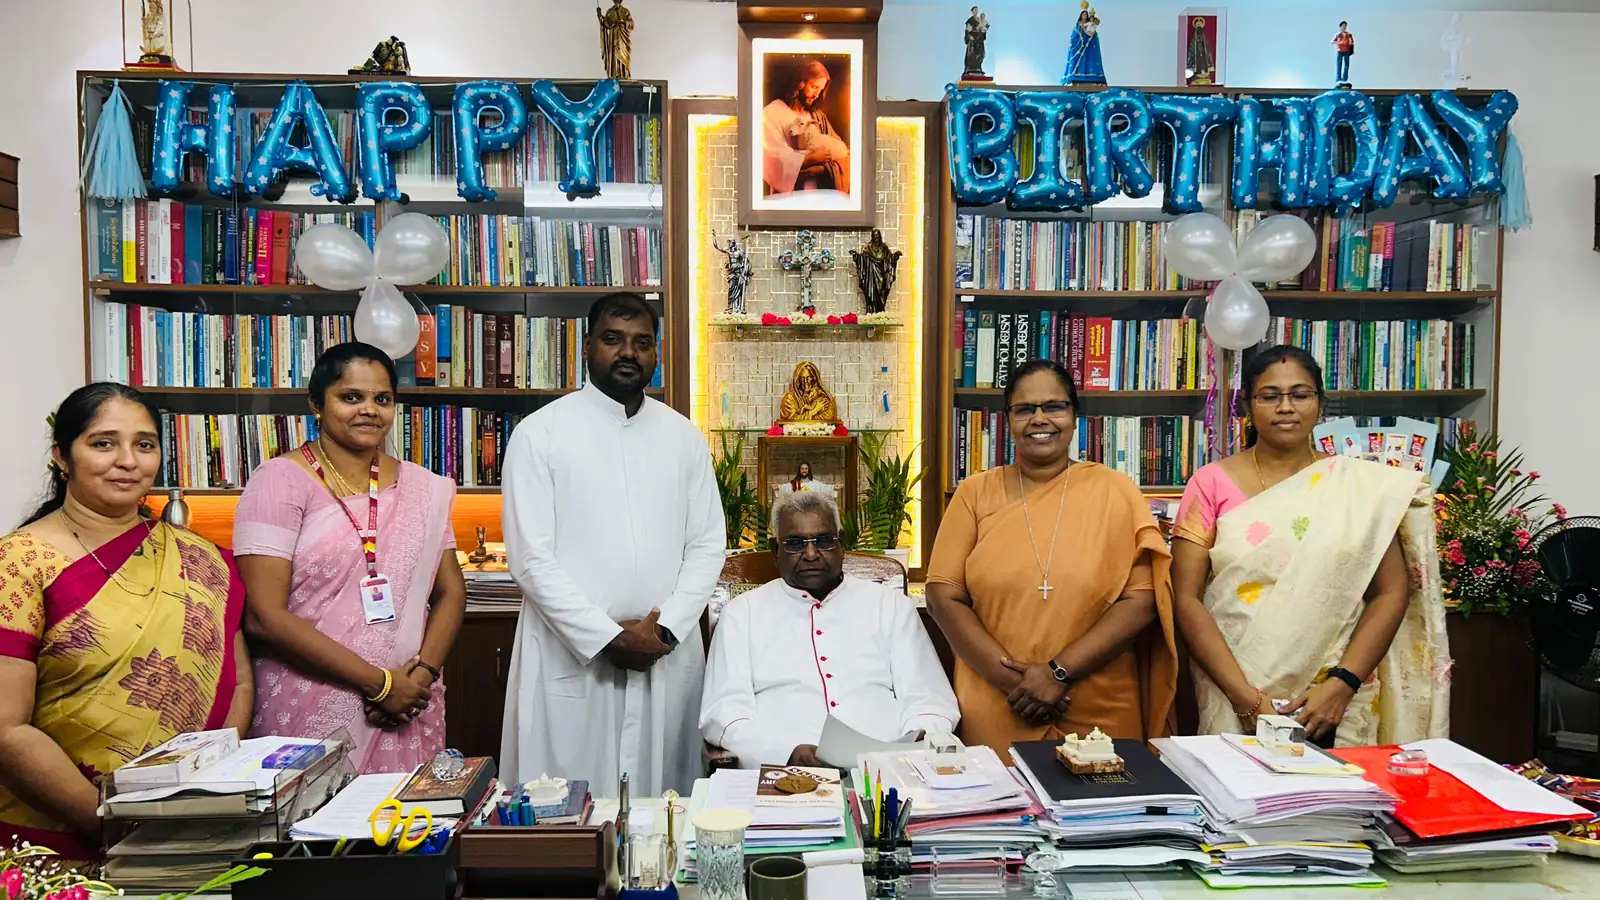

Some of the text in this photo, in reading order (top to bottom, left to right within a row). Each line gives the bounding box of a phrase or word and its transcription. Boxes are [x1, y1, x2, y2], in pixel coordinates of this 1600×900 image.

[150, 78, 1518, 215] HAPPY BIRTHDAY
[420, 320, 432, 373] ESV
[998, 314, 1011, 388] CATHOLICISM
[405, 425, 410, 434] BY
